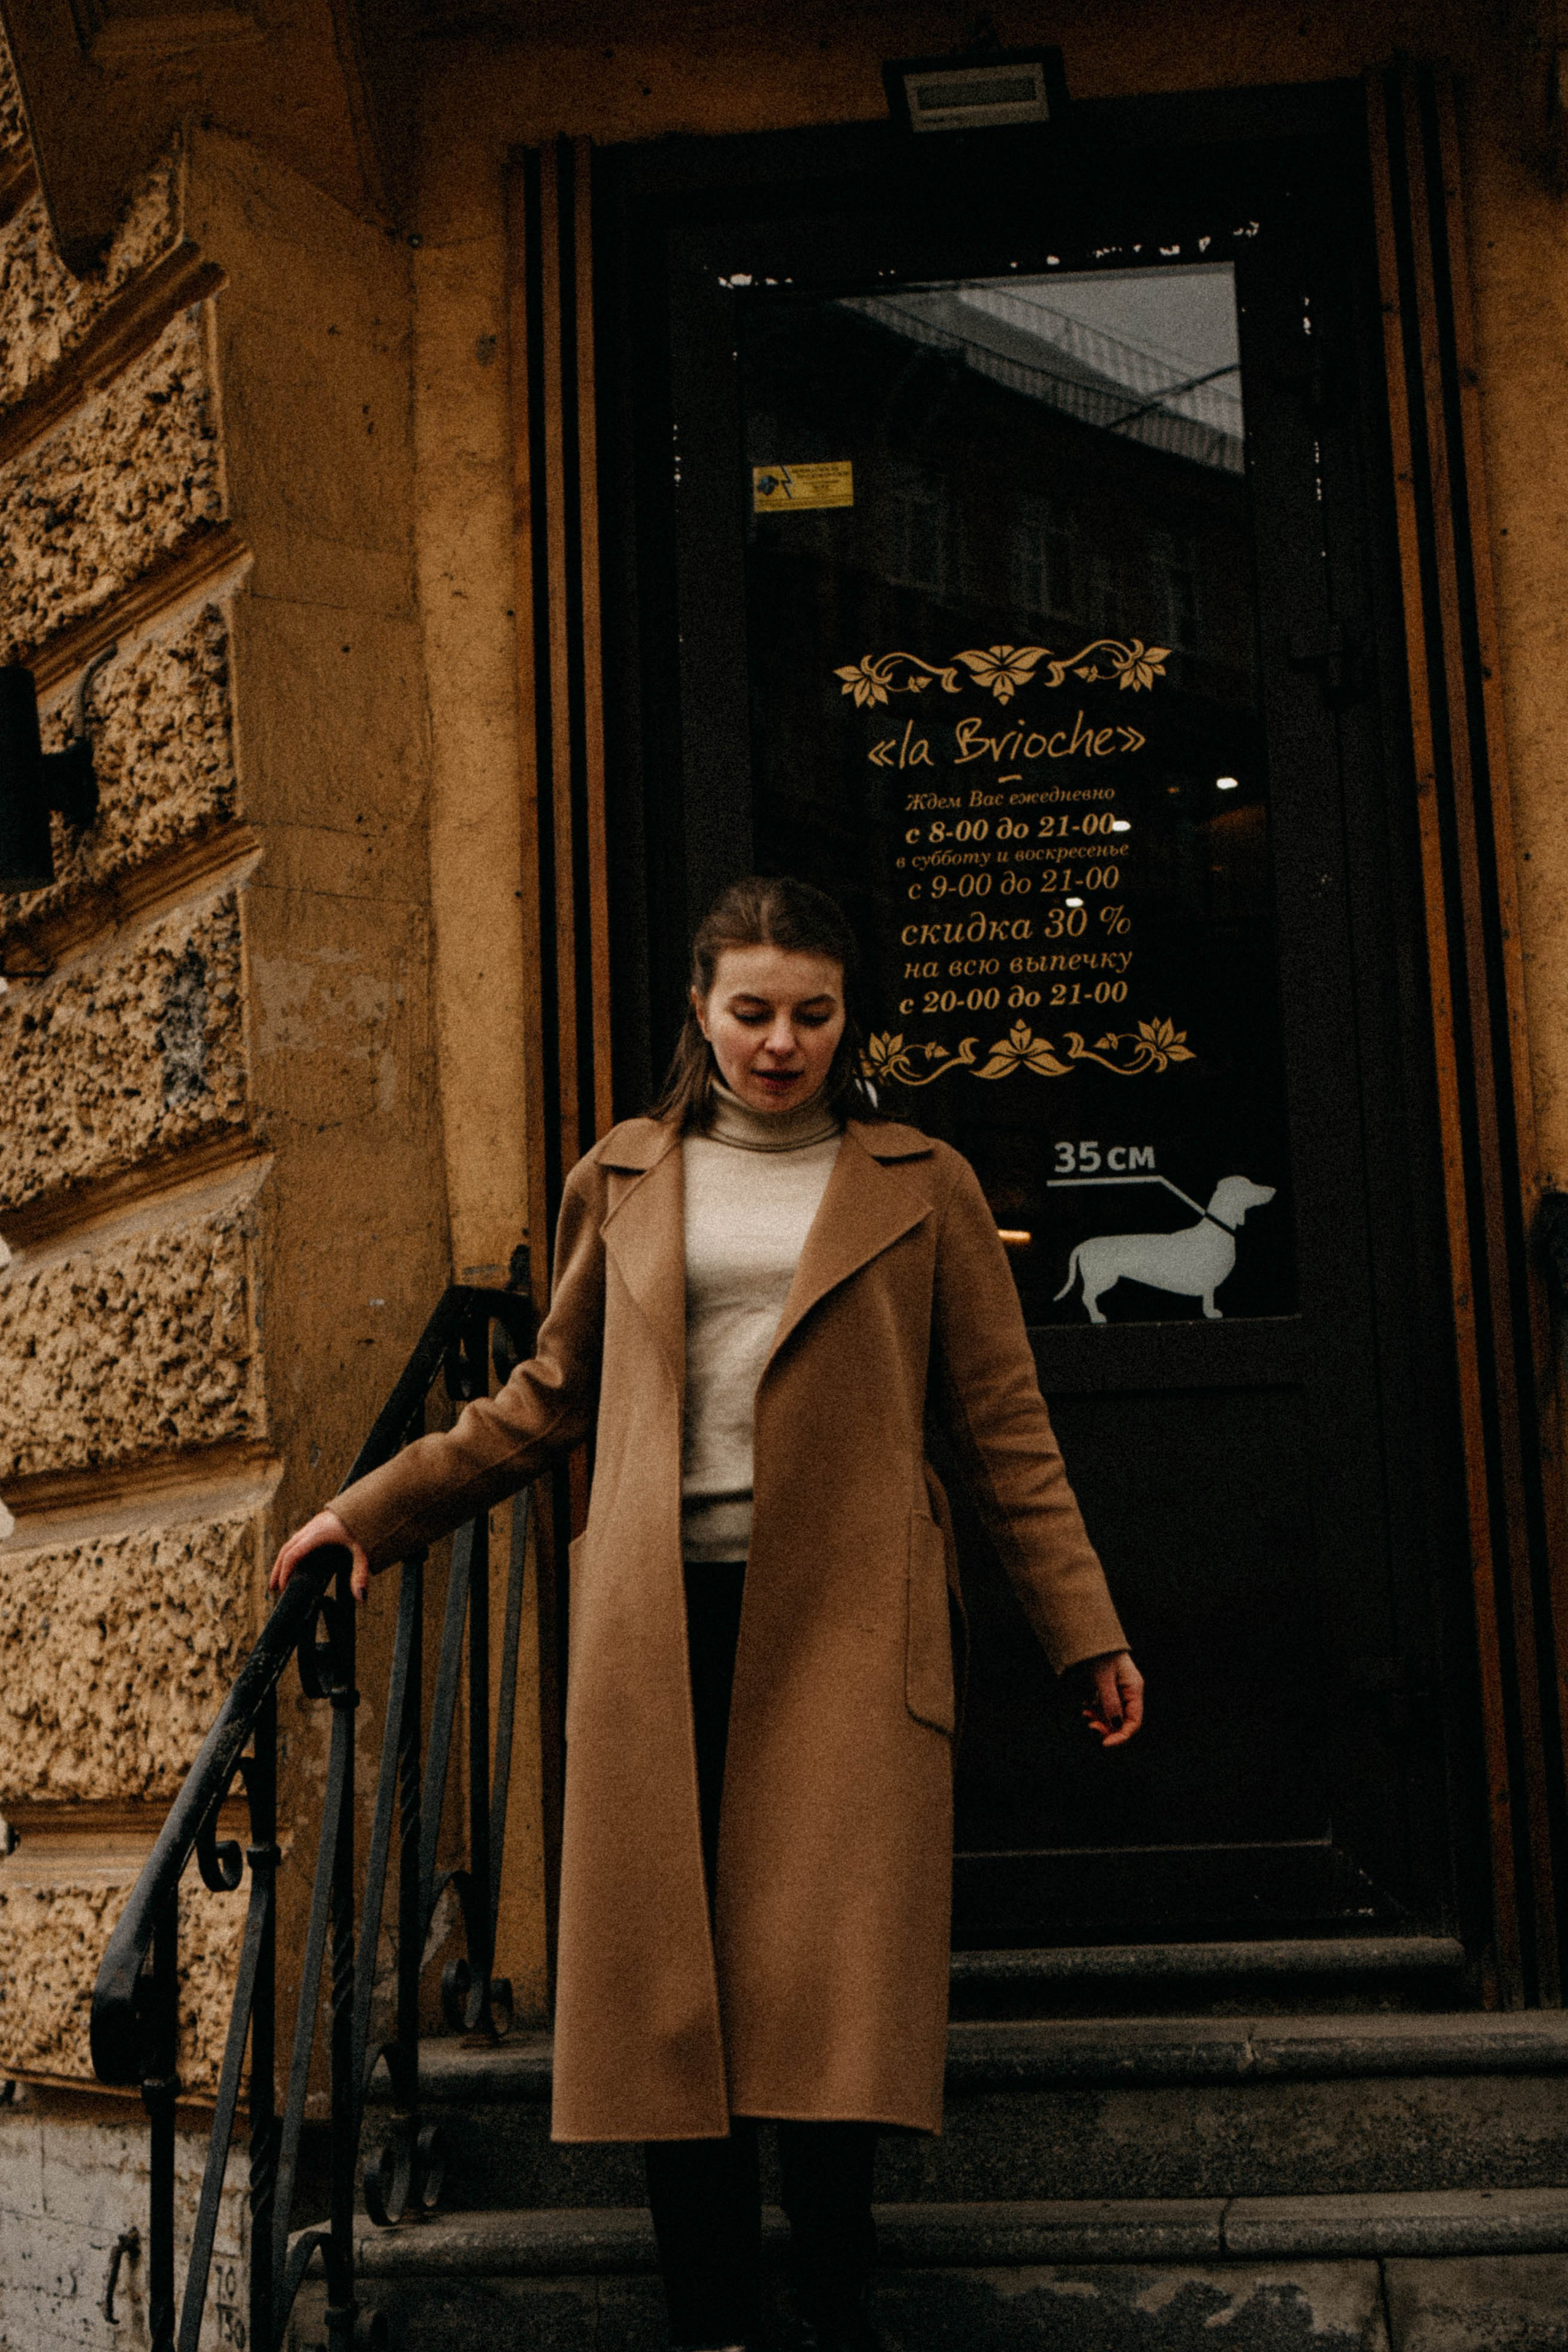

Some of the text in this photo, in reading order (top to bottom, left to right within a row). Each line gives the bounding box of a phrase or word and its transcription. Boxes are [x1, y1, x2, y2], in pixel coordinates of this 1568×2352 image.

[905, 785, 1115, 811] Ждем Вас ежедневно
[905, 812, 1115, 844] с 8-00 до 21-00
[895, 843, 1129, 871] в субботу и воскресенье
[908, 865, 1120, 900] с 9-00 до 21-00
[900, 905, 1131, 946] скидка 30 %
[904, 951, 1133, 979] на всю выпечку
[899, 981, 1128, 1015] с 20-00 до 21-00
[1054, 1140, 1101, 1173] 35
